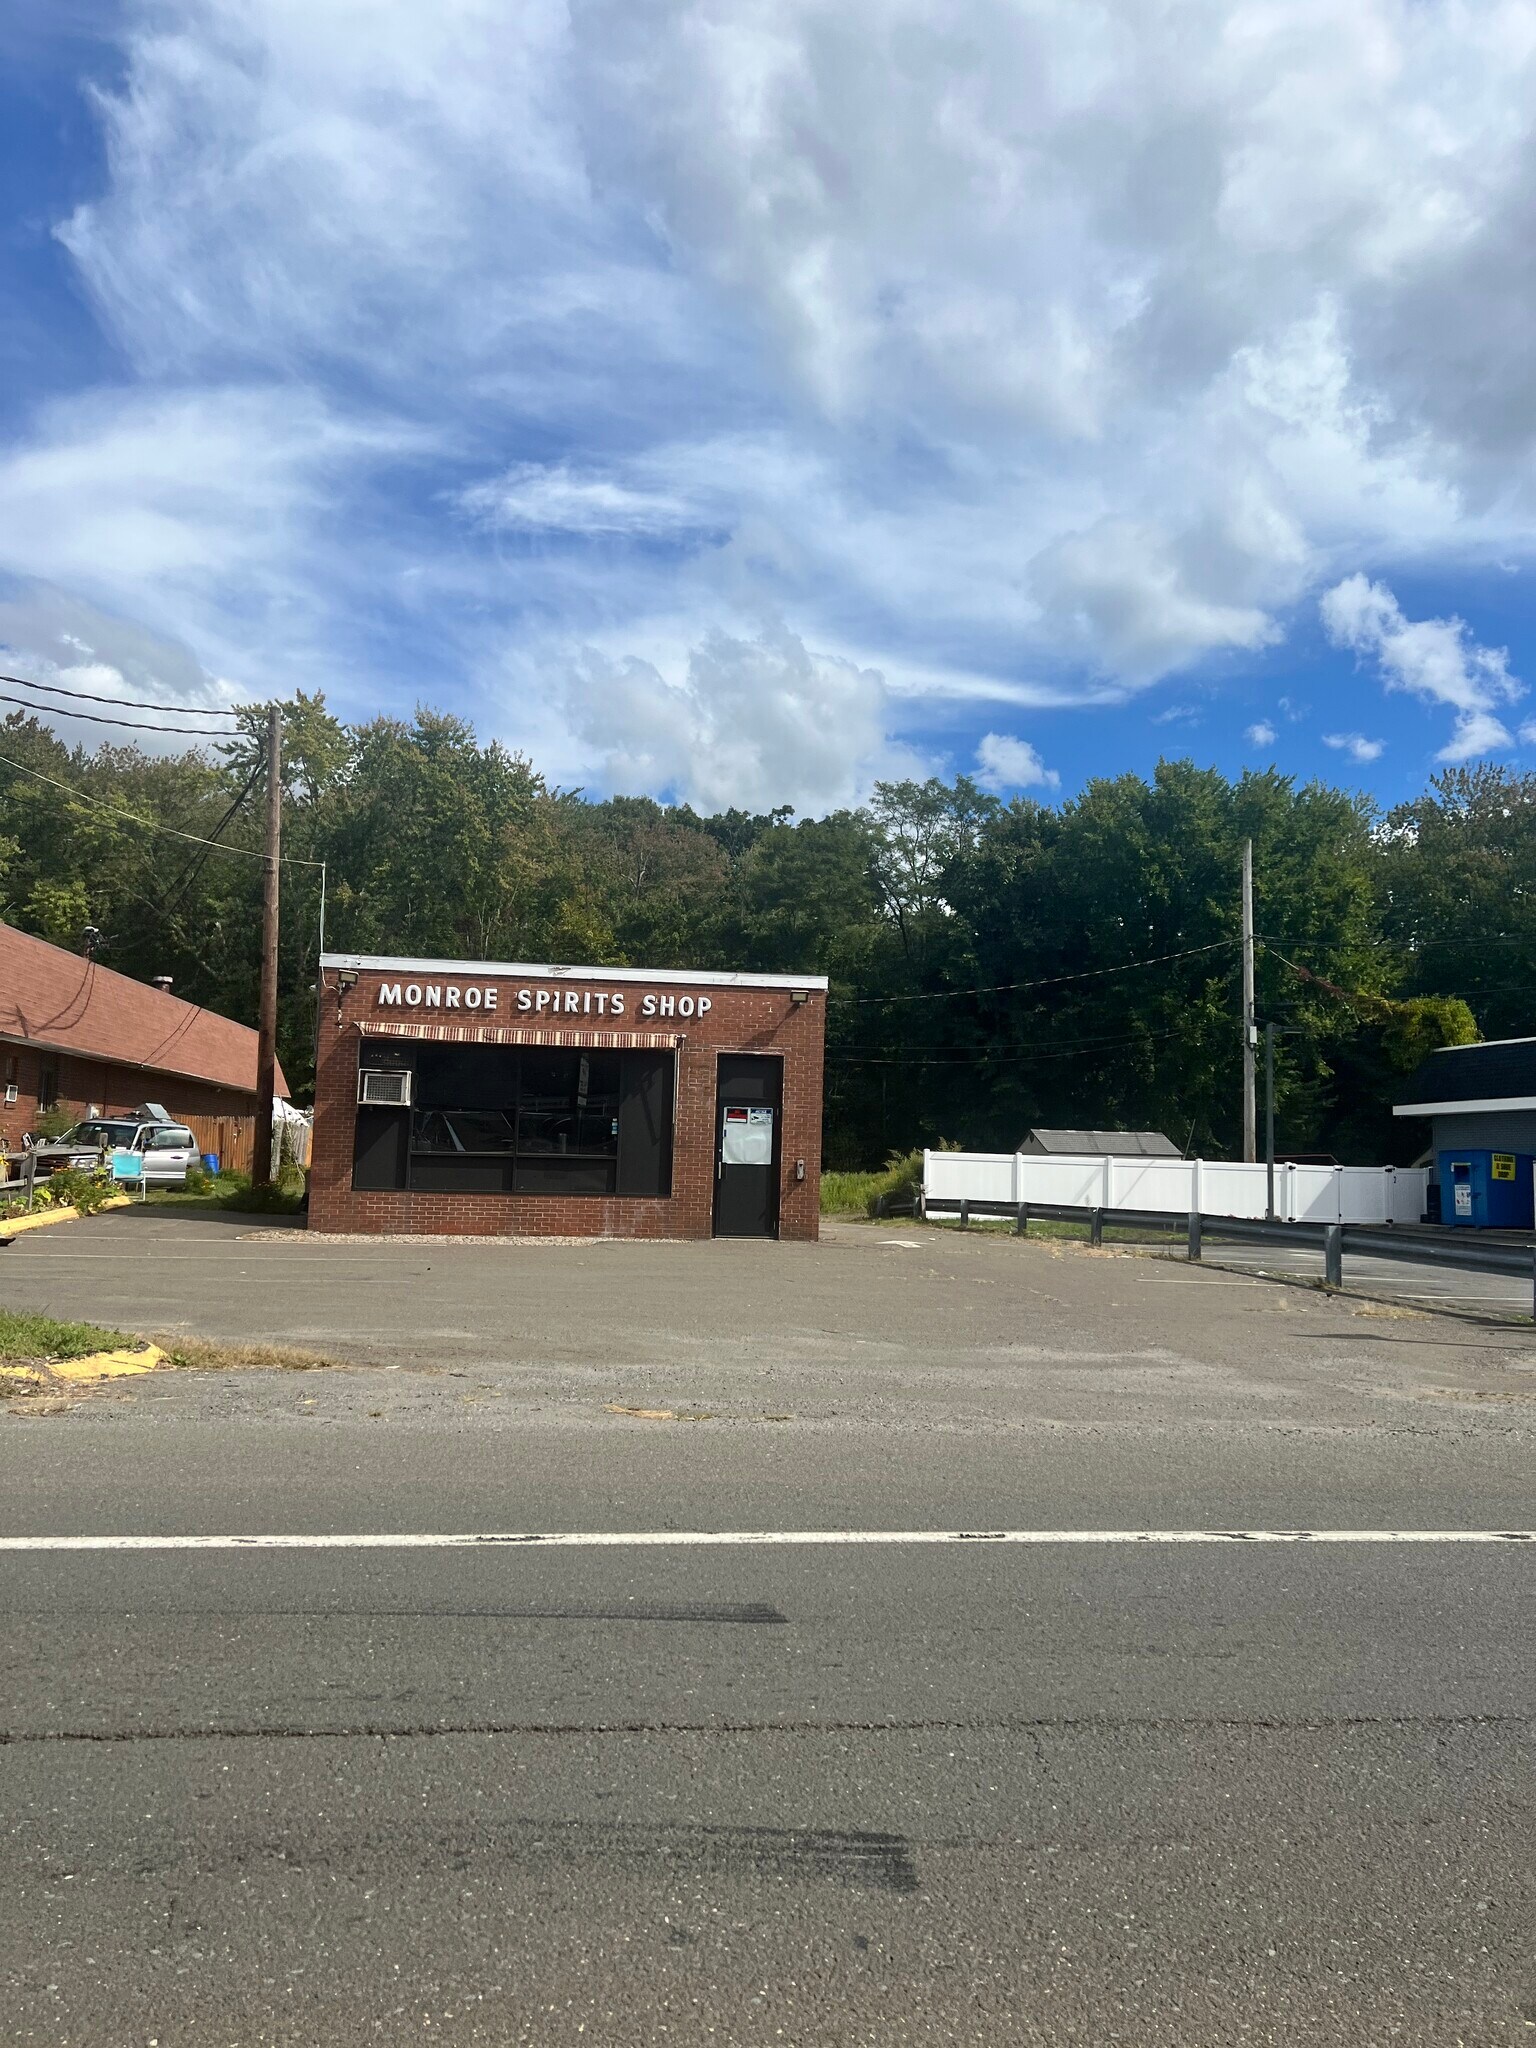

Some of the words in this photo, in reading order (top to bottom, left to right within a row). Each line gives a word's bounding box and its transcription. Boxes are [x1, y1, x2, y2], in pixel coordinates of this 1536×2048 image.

[378, 983, 498, 1010] MONROE
[517, 989, 625, 1015] SPIRITS
[642, 994, 712, 1018] SHOP
